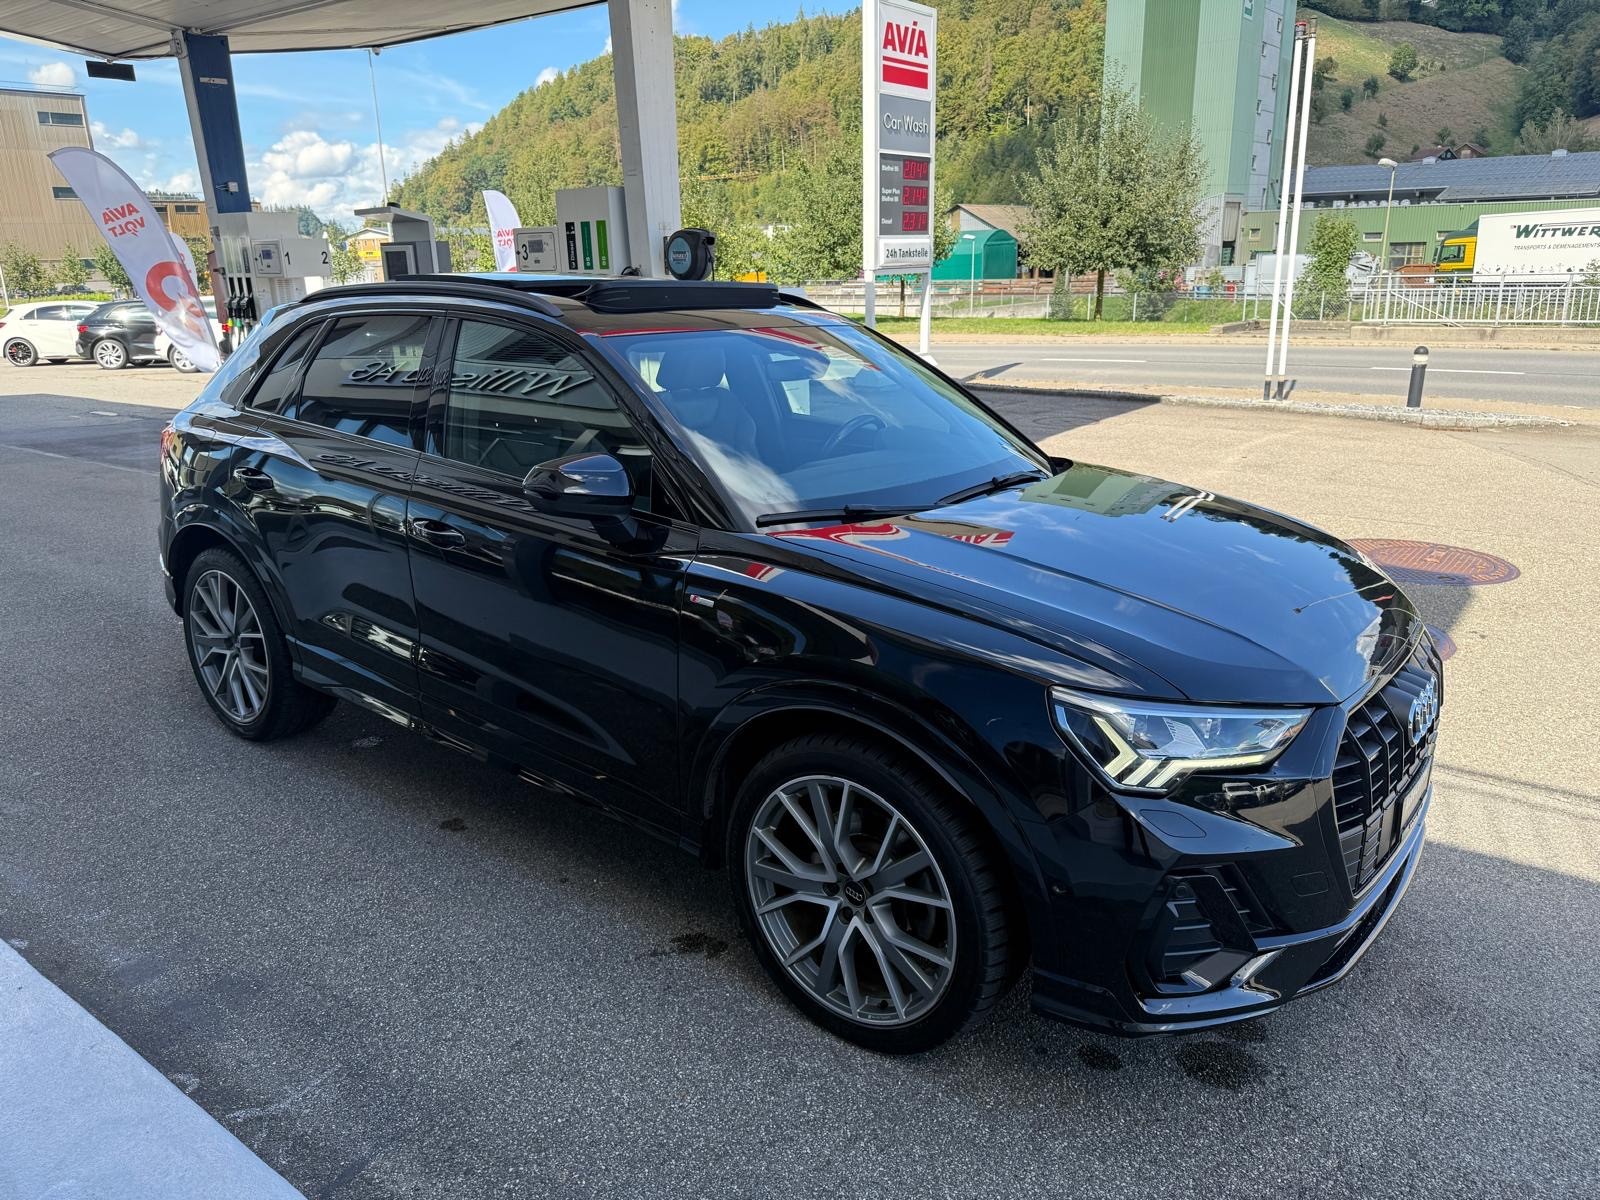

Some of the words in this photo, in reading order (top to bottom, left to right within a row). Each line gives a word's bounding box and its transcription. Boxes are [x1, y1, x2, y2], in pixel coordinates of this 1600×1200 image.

[884, 112, 901, 130] Car
[903, 115, 929, 134] Wash
[1516, 223, 1600, 238] WITTWER
[284, 251, 291, 265] 1
[321, 251, 329, 264] 2
[521, 243, 529, 261] 3
[886, 248, 897, 258] 24h
[898, 247, 928, 258] Tankstelle
